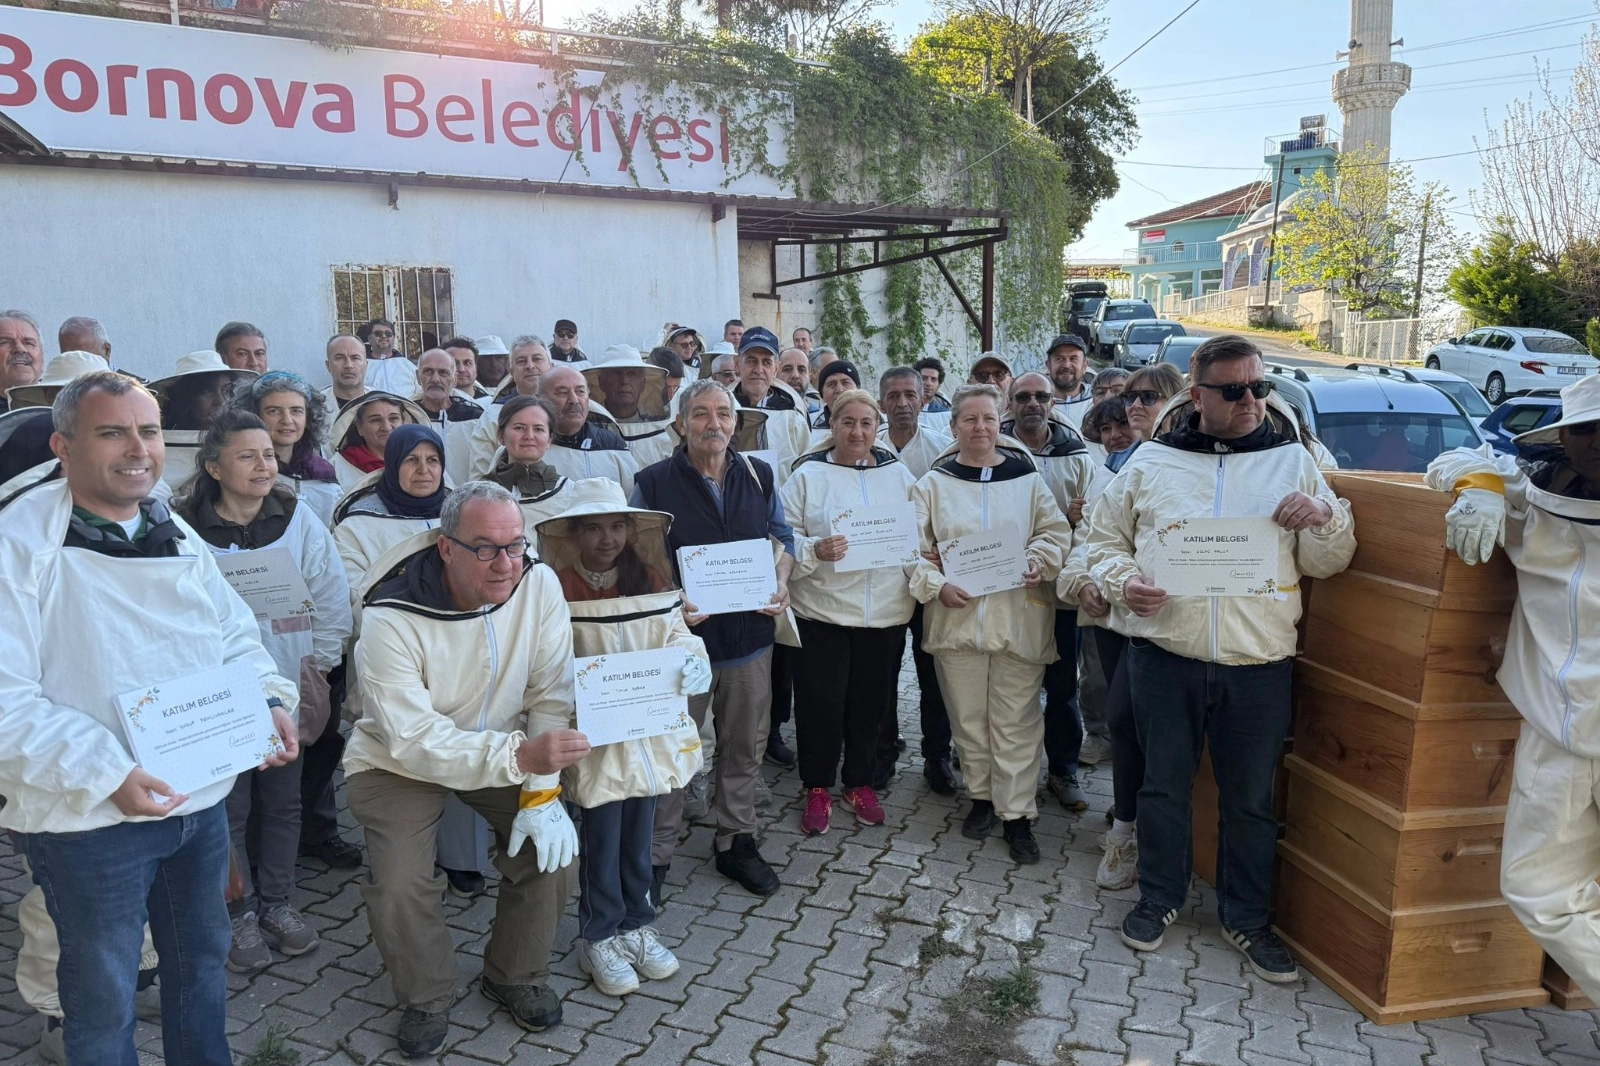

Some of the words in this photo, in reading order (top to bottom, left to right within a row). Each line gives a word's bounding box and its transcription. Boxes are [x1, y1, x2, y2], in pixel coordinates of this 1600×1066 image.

[0, 33, 356, 134] Bornova
[383, 73, 731, 172] Belediyesi
[851, 520, 872, 528] KATILIM
[1216, 535, 1248, 543] BELGESİ
[959, 548, 980, 556] KATILIM
[705, 558, 729, 566] KATILIM
[236, 566, 268, 577] BELGESİ
[602, 672, 631, 683] KATILIM
[632, 668, 661, 679] BELGESİ
[162, 701, 197, 719] KATILIM
[197, 688, 232, 708] BELGESİ
